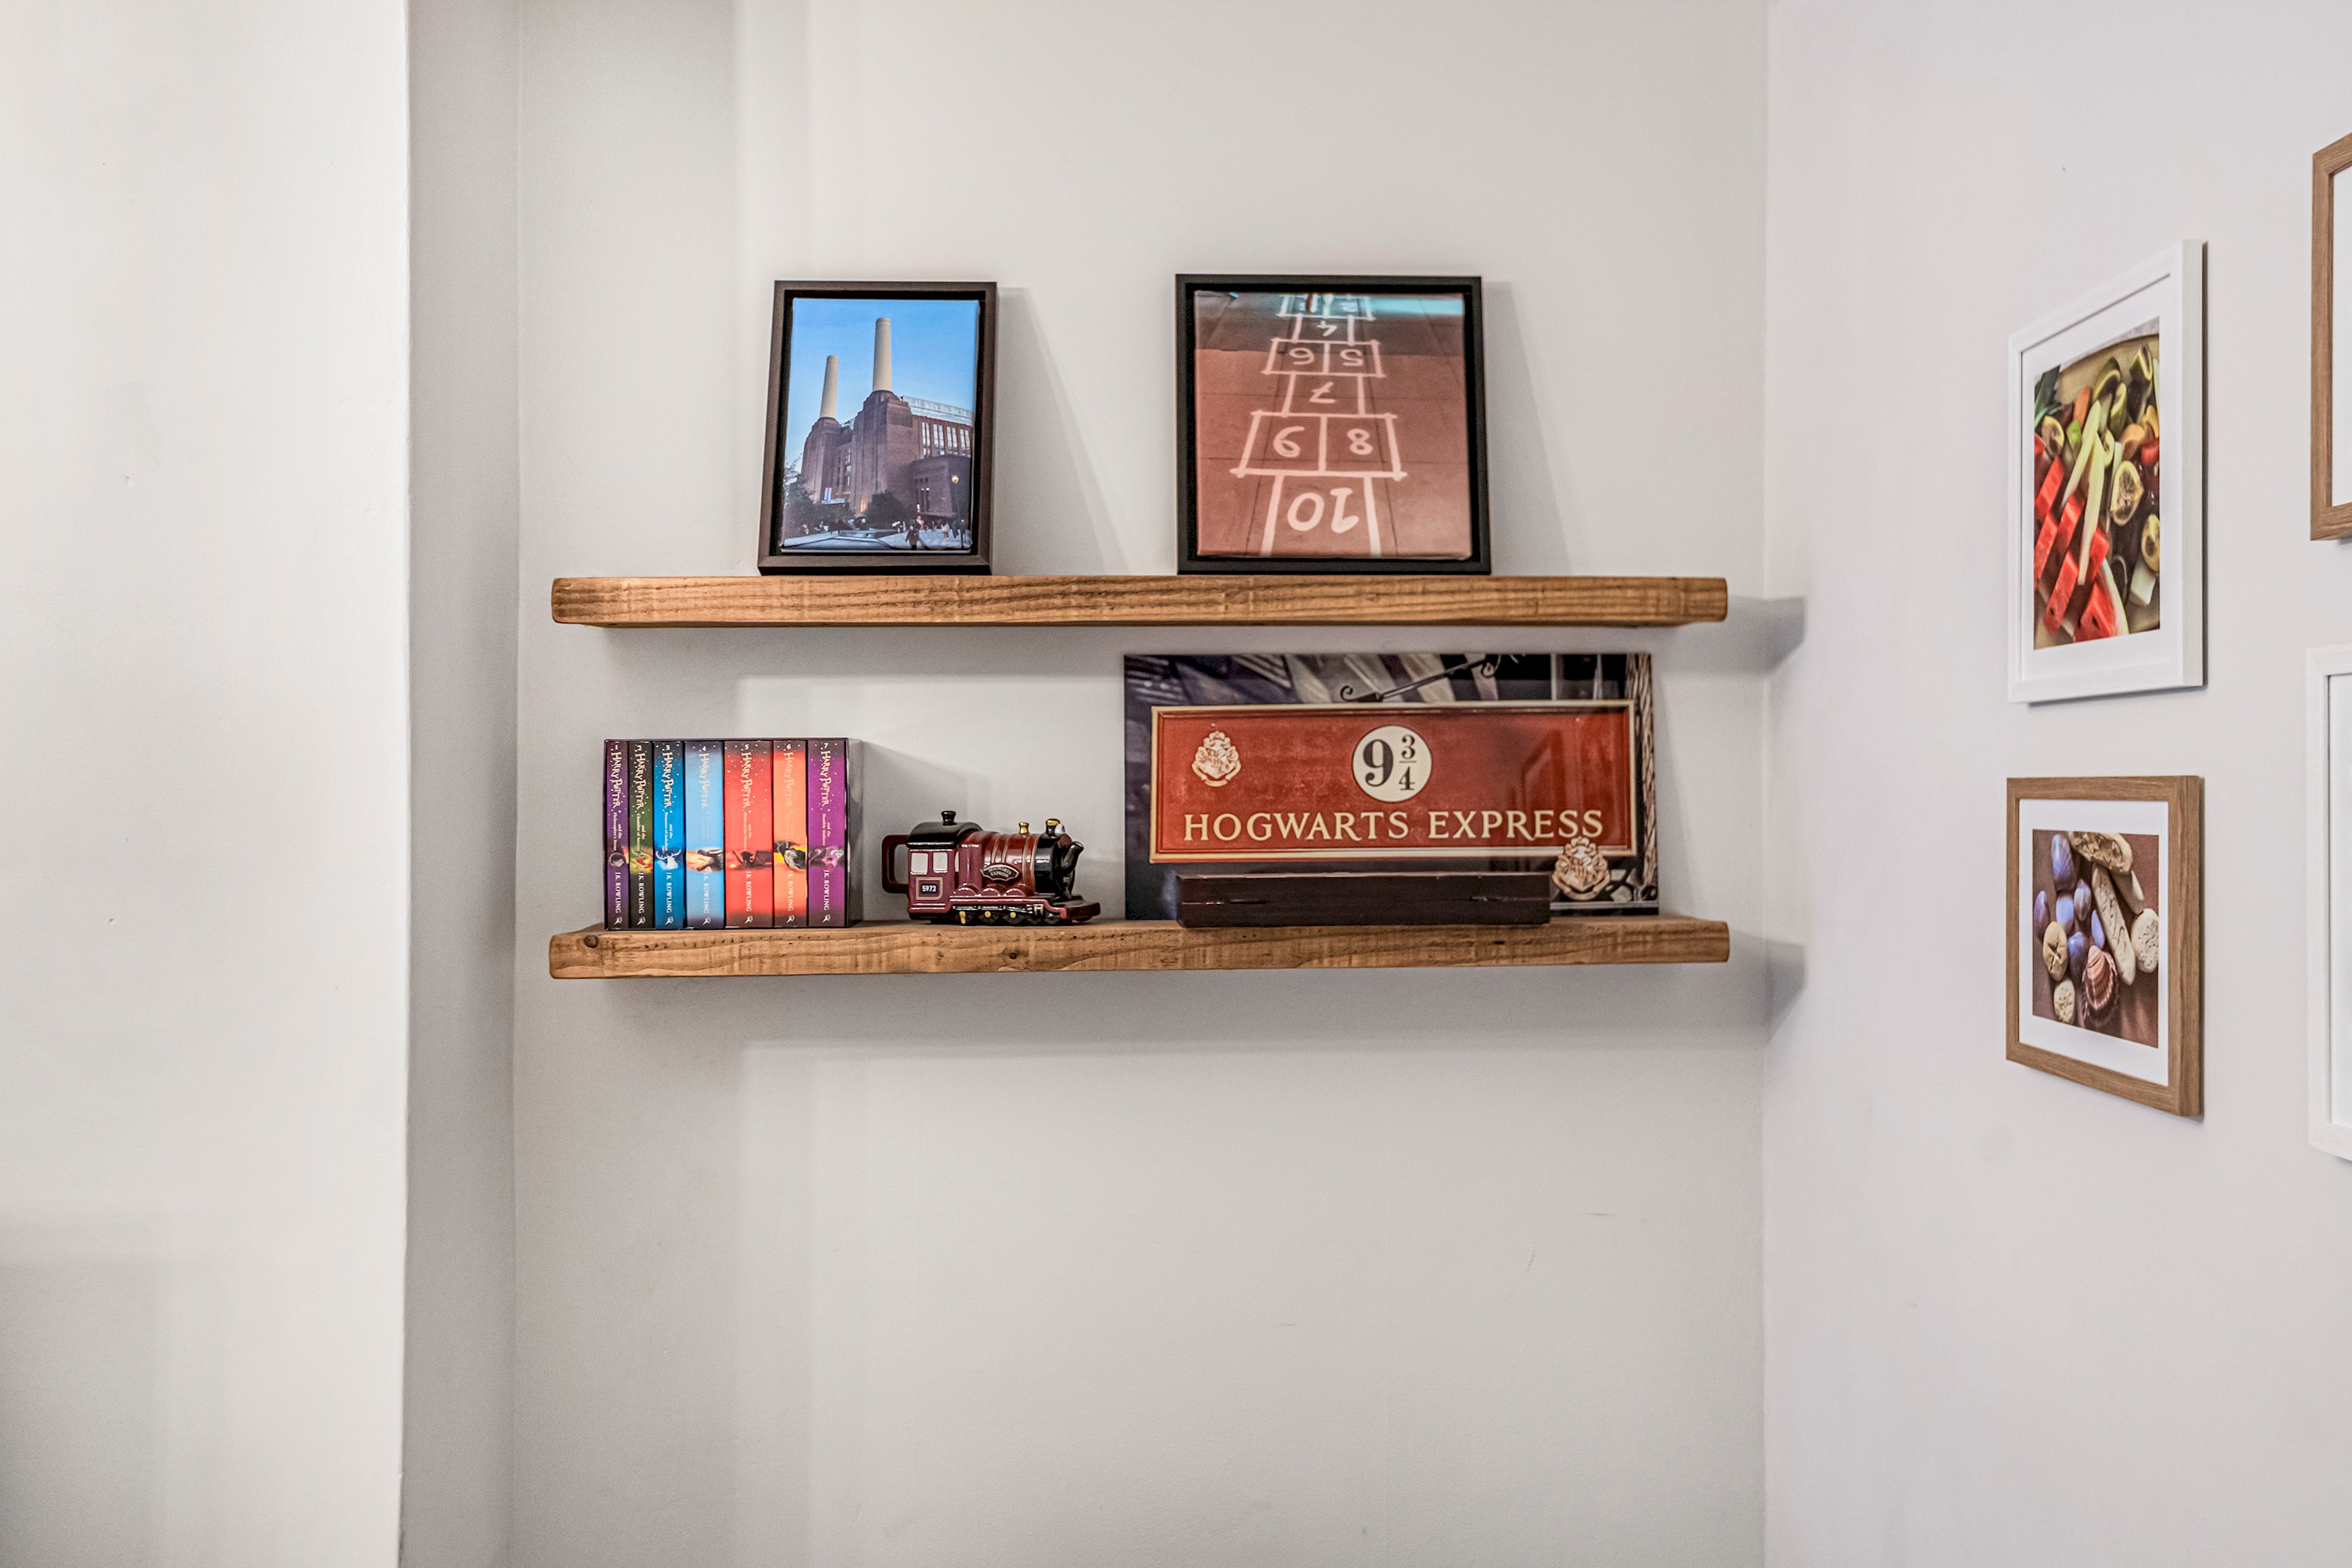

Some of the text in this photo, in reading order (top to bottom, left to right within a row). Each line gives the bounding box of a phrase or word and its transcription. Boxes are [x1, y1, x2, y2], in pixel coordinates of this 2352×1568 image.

[1317, 320, 1338, 336] 4
[1340, 349, 1363, 366] 5
[1309, 382, 1335, 404] 7
[1346, 428, 1374, 456] 8
[1287, 487, 1360, 533] 10
[610, 752, 622, 808] HARRY POTTER
[633, 753, 647, 810] HARRY POTTER
[661, 752, 674, 808] HARRY POTTER
[699, 753, 710, 780] HARRY
[740, 752, 753, 808] HARRY POTTER
[819, 750, 832, 807] HARRY POTTER
[1183, 809, 1603, 841] HOGWARTS EXPRESS
